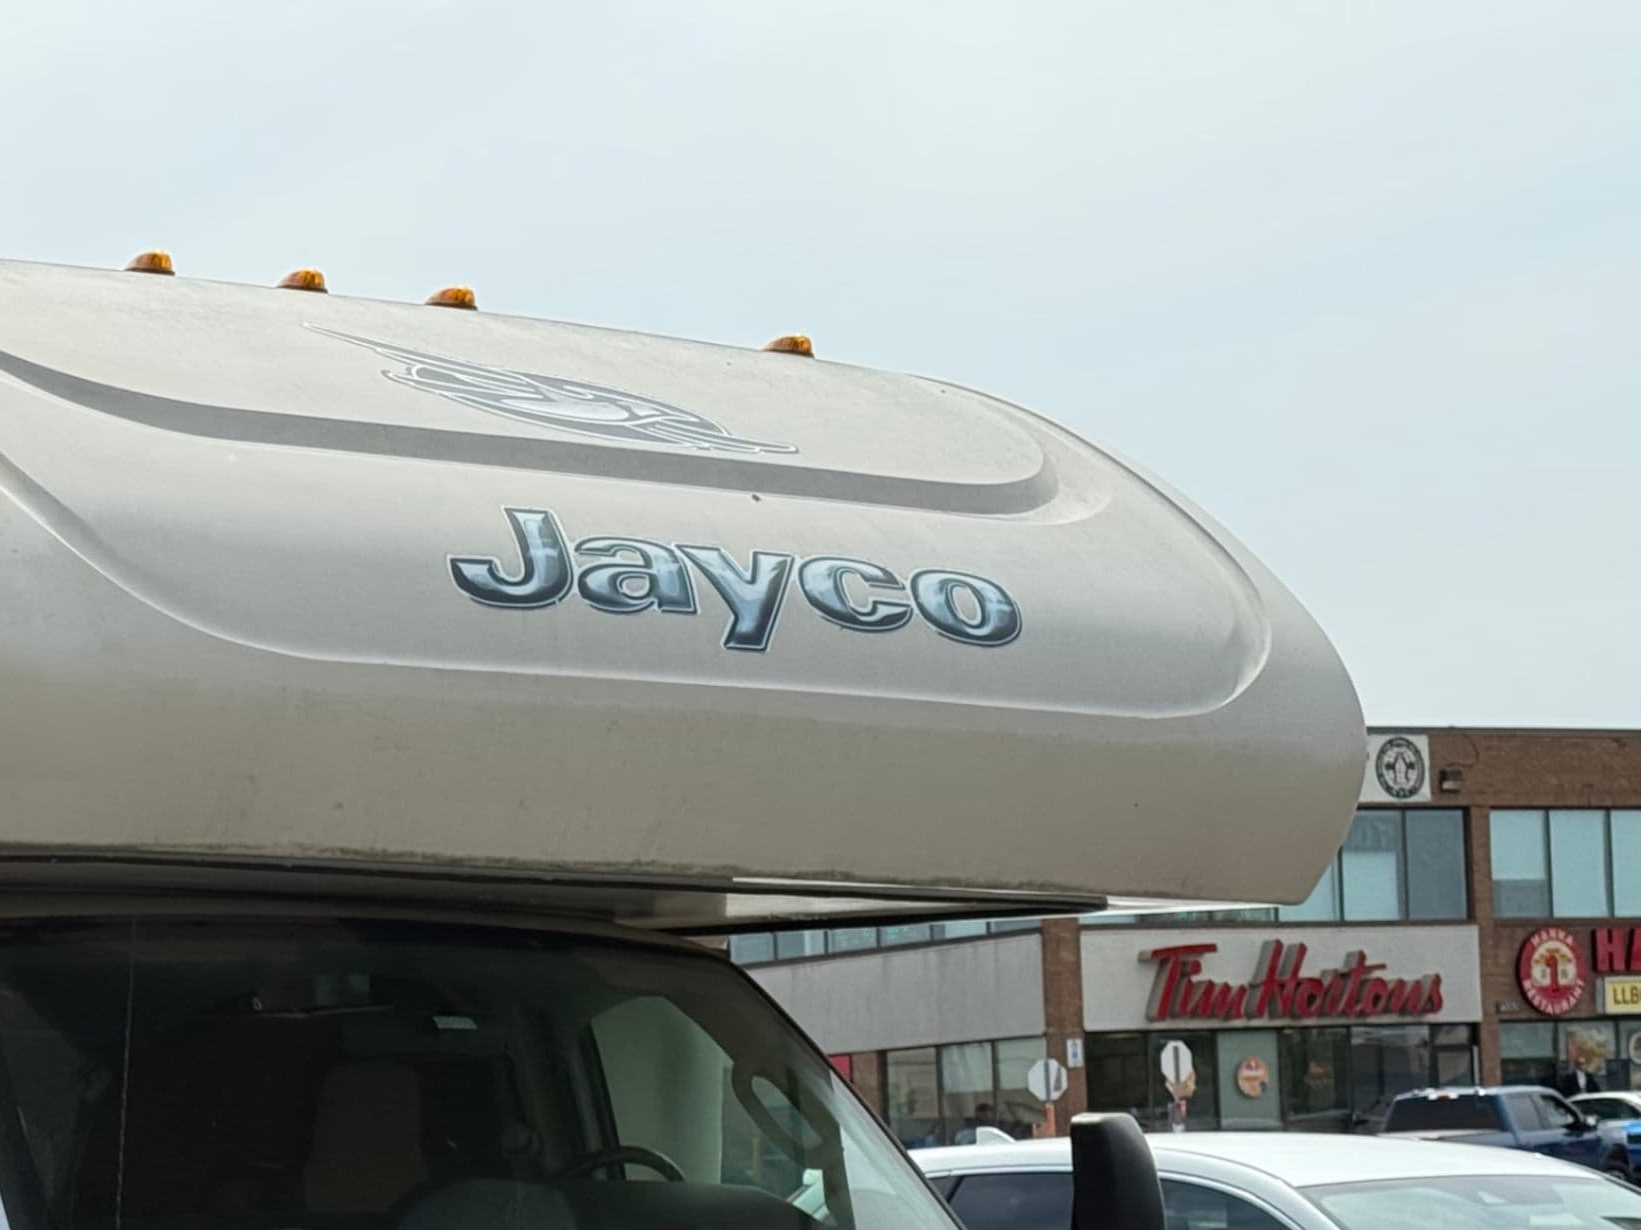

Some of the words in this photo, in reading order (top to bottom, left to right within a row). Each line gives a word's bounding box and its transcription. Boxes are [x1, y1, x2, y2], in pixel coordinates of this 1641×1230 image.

[448, 505, 1023, 653] Jayco
[1142, 943, 1247, 1021] Tim
[1247, 939, 1444, 1018] Hortons
